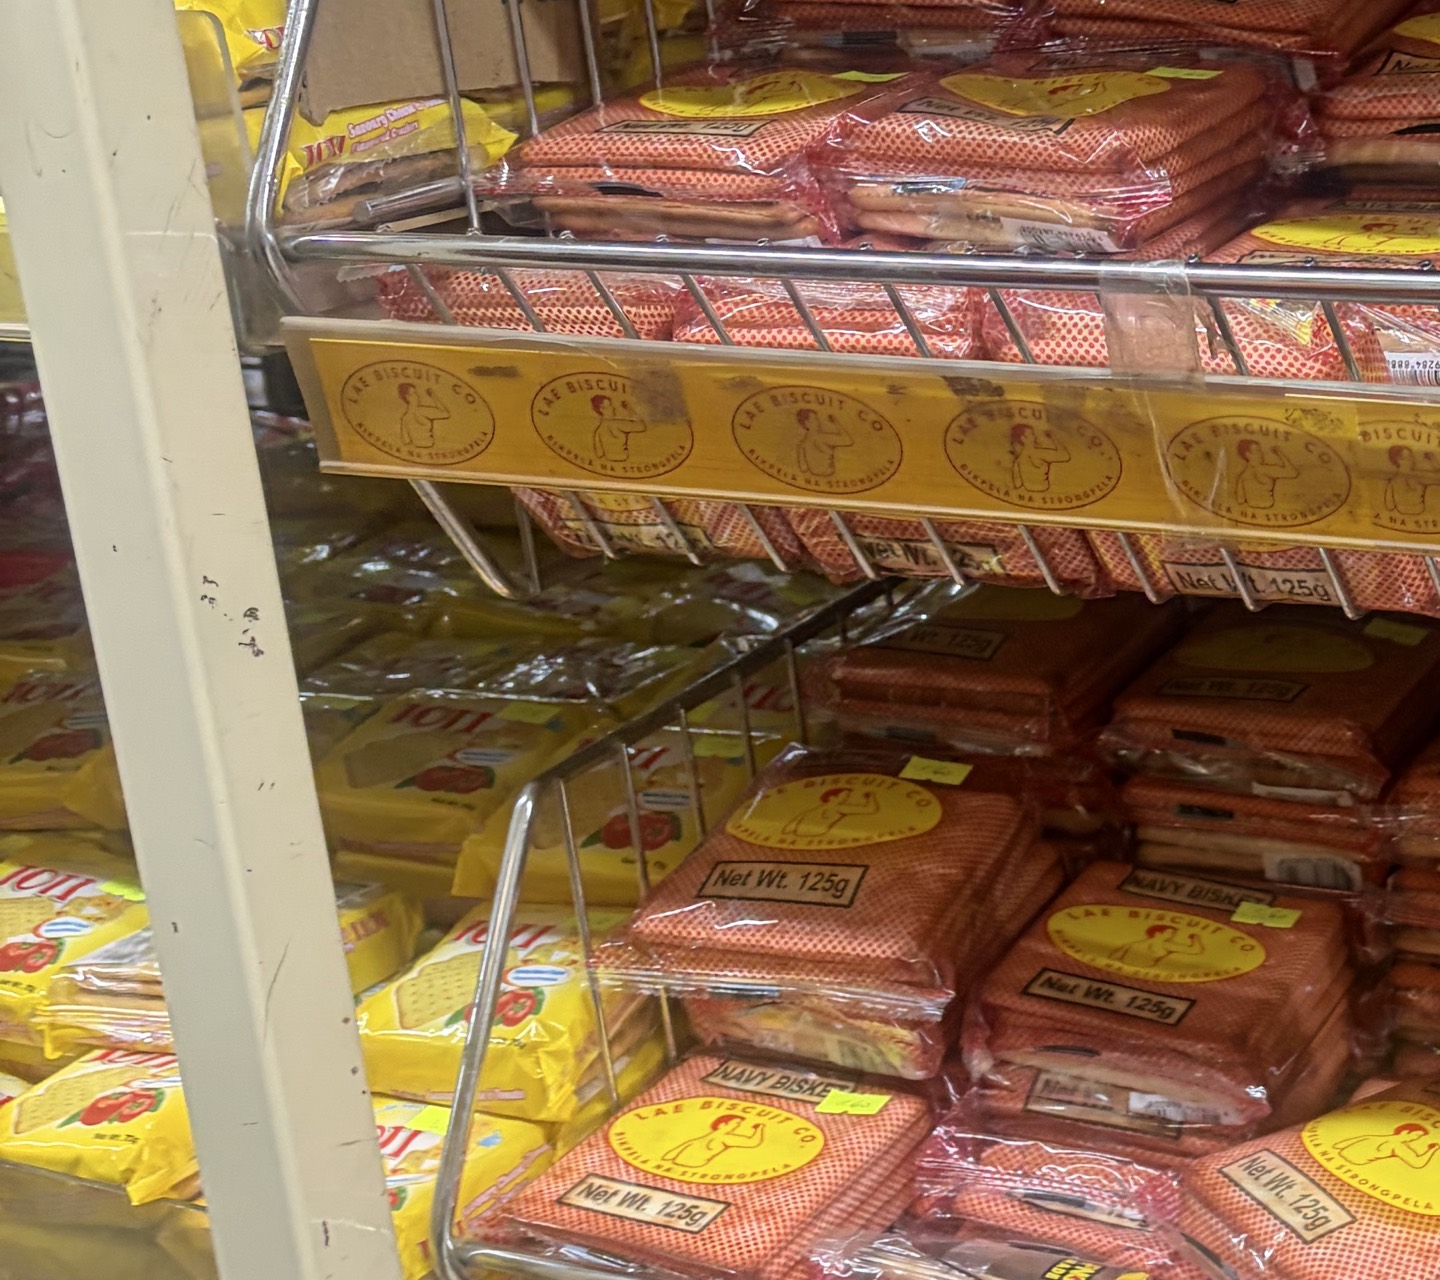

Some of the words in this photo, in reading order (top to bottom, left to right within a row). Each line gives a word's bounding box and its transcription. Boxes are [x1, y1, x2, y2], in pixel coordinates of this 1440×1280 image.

[345, 373, 372, 406] LAE
[374, 367, 443, 389] BISCUIT
[1214, 419, 1292, 445] BISCUIT
[712, 868, 759, 891] Net
[760, 870, 793, 891] Wt.
[799, 873, 851, 899] 125g
[1041, 976, 1091, 999] Net
[1124, 994, 1175, 1019] 125g
[633, 1103, 683, 1122] LAE
[699, 1097, 787, 1122] BISCUIT
[653, 1160, 674, 1172] NA
[675, 1160, 792, 1183] STRONGPELA
[576, 1179, 617, 1204] Net
[617, 1186, 654, 1211] Wt.
[660, 1194, 707, 1228] 125g
[1238, 1154, 1275, 1186] Net
[1266, 1170, 1294, 1198] Wt.
[1286, 1189, 1330, 1231] 125g
